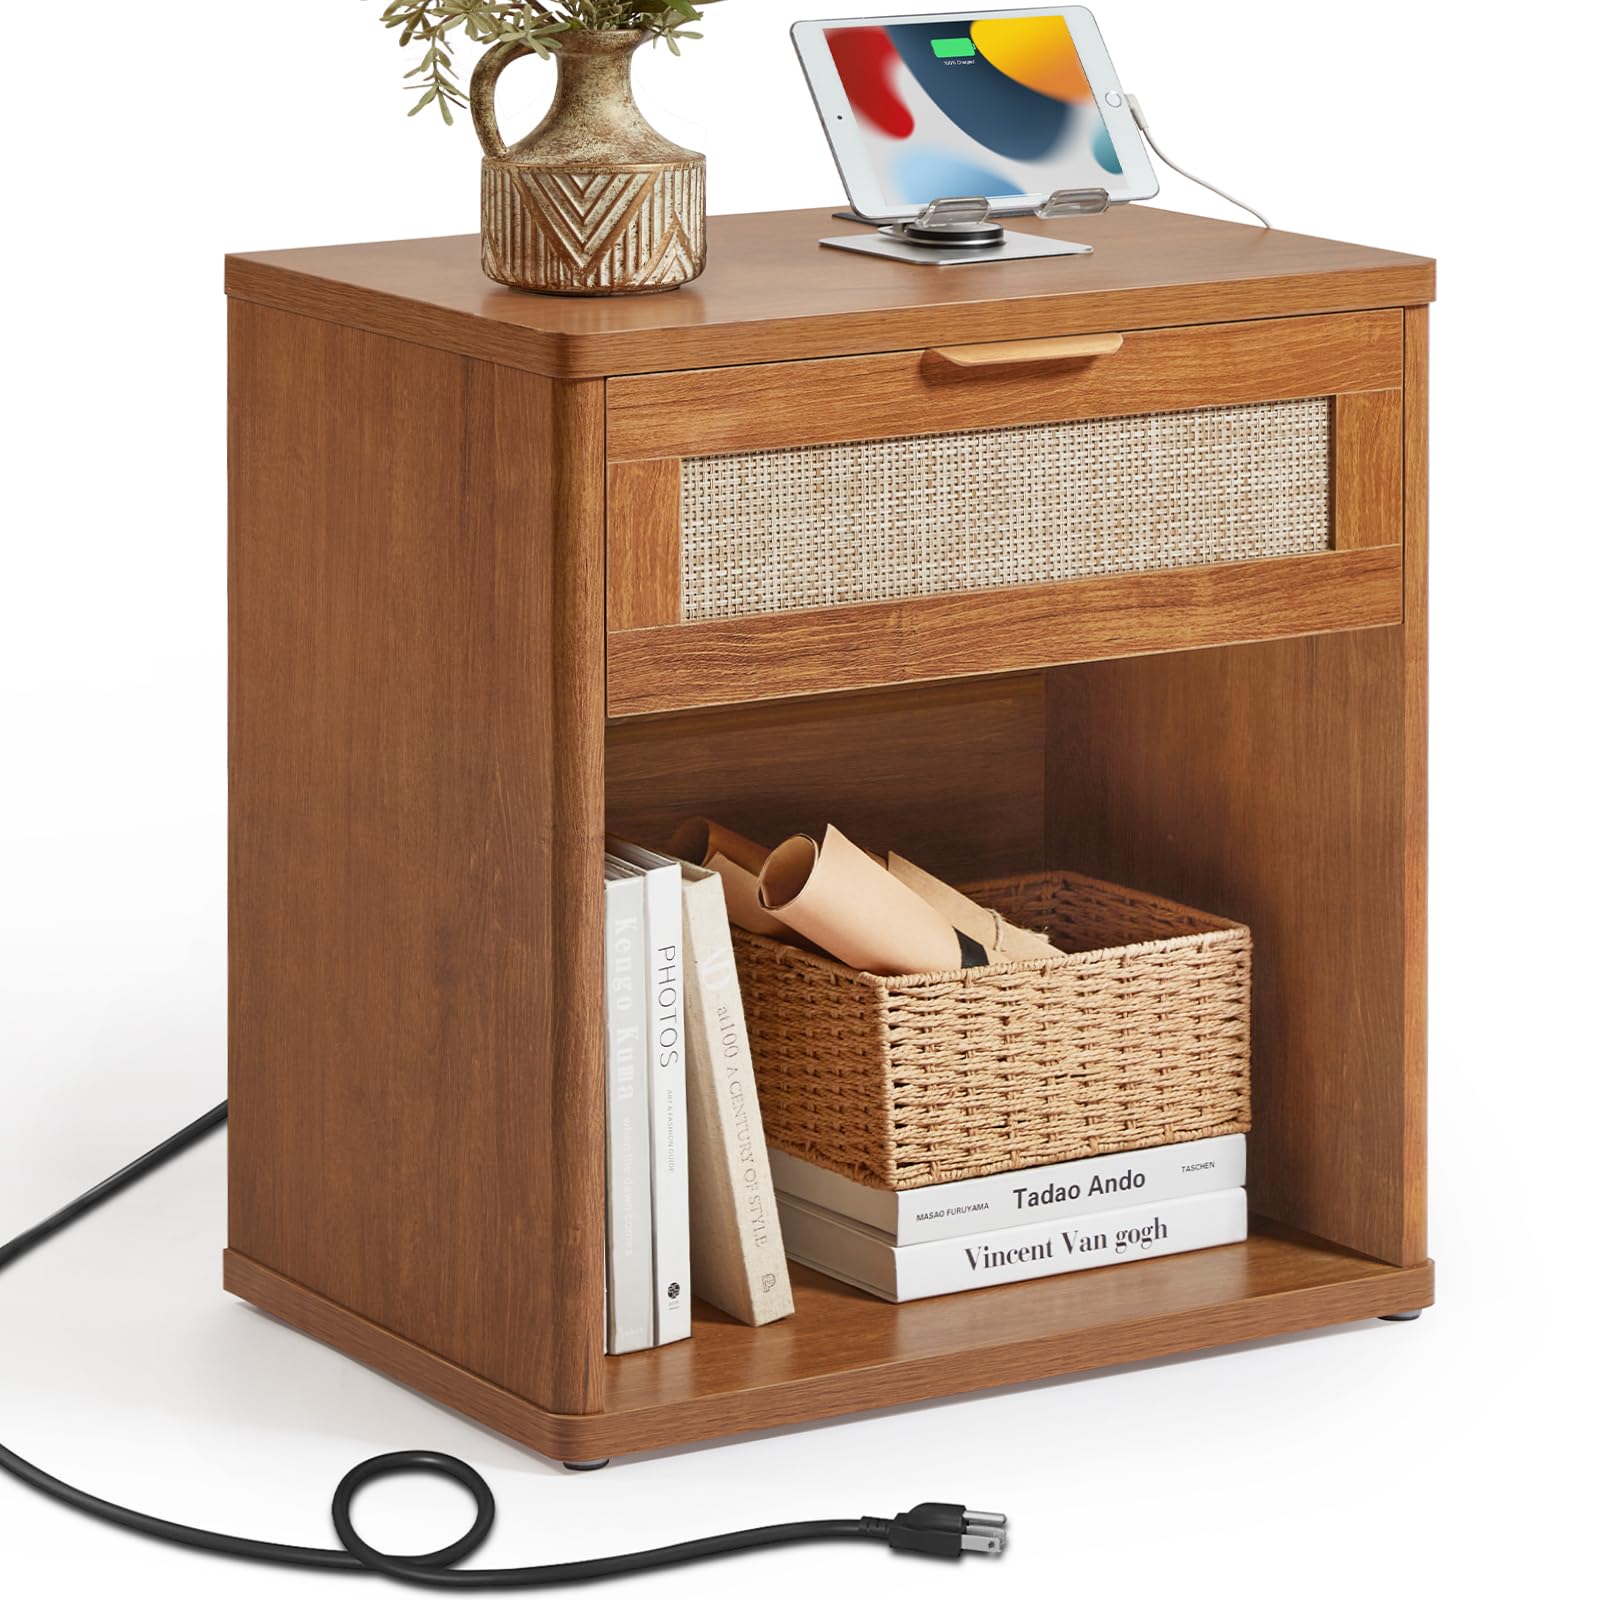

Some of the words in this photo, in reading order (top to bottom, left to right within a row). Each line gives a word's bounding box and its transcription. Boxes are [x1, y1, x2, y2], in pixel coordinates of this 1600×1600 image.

[612, 916, 639, 1011] Kengo
[658, 945, 678, 1067] PHOTOS
[615, 1024, 640, 1100] Kuma
[729, 1080, 754, 1164] CENTURY
[743, 1167, 760, 1191] OF
[1013, 1183, 1081, 1209] Tadao
[1088, 1169, 1146, 1197] Ando
[1181, 1161, 1215, 1174] TASCHEN
[749, 1195, 768, 1248] STYLE
[916, 1210, 945, 1222] MASAO
[946, 1202, 989, 1217] FURUYAMA
[964, 1237, 1054, 1271] Vincent
[1061, 1229, 1107, 1255] Van
[1115, 1217, 1168, 1255] gogh
